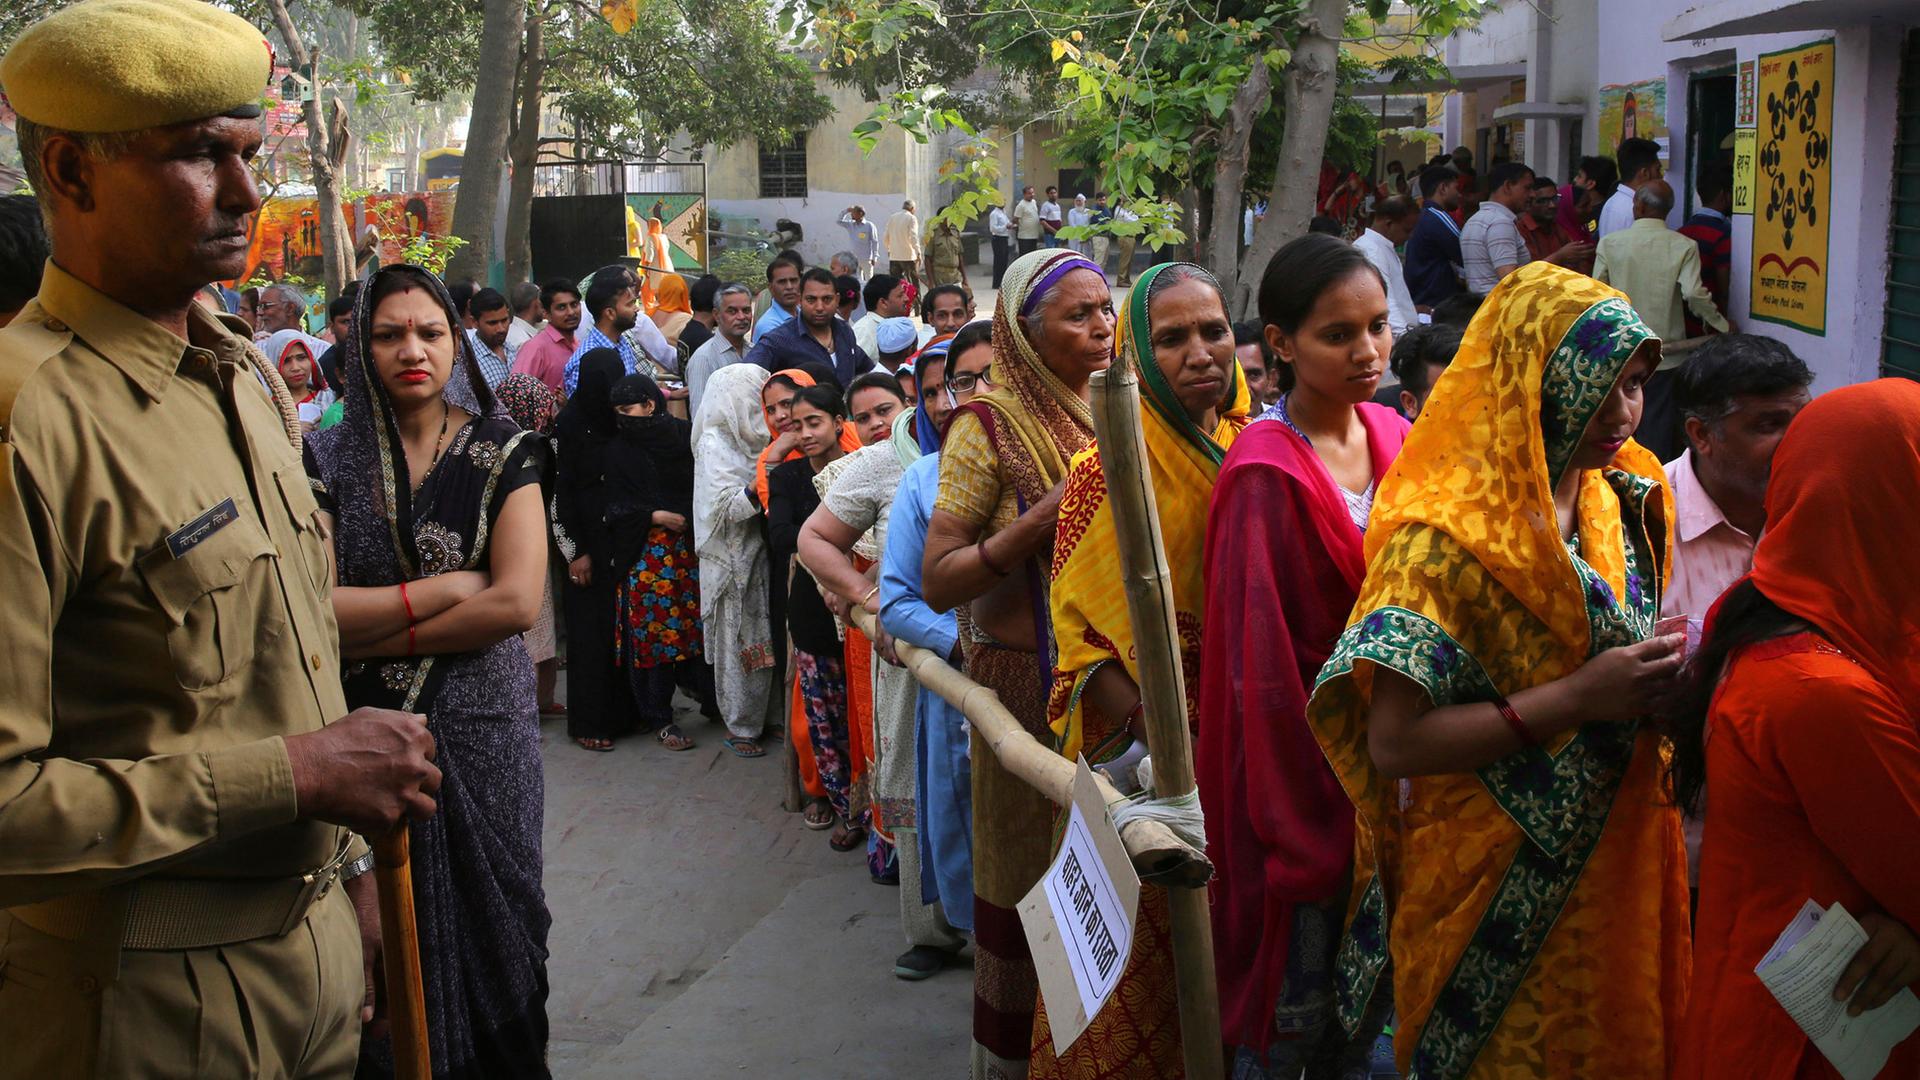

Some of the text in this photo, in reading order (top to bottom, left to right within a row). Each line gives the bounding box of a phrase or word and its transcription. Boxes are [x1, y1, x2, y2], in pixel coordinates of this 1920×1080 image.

[1735, 185, 1747, 206] 122
[1062, 846, 1119, 981] बाहर जाने का रास्ता
